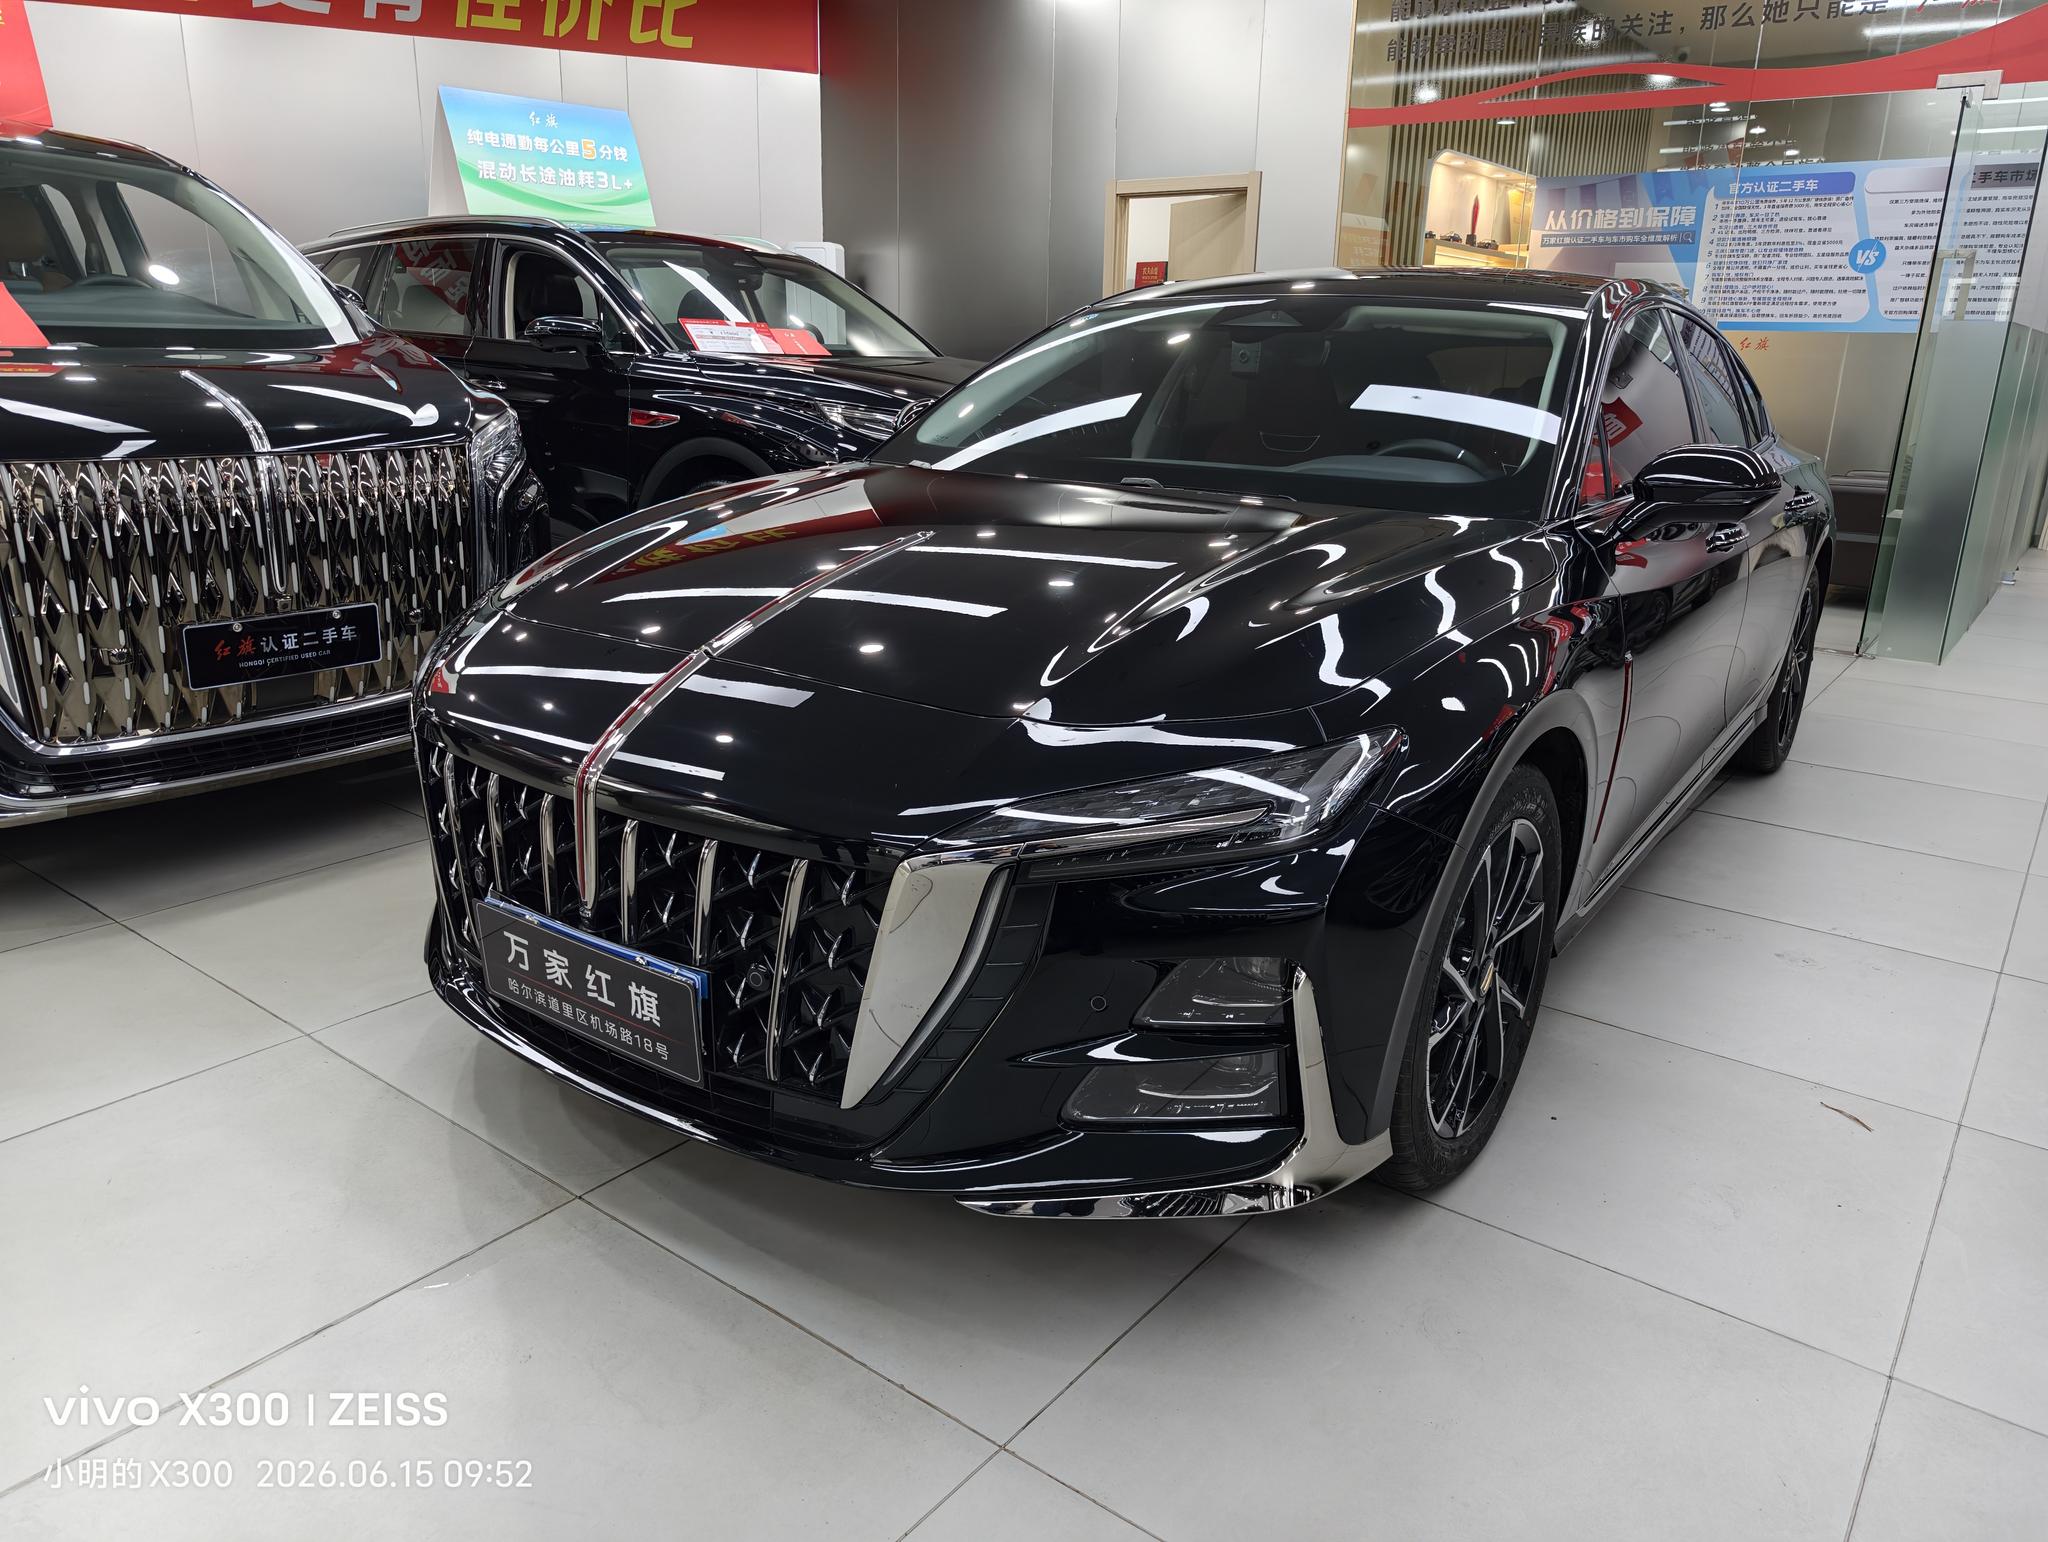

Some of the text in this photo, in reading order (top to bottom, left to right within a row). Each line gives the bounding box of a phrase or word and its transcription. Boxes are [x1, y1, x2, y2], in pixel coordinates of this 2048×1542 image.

[529, 111, 559, 129] 红旗
[467, 128, 629, 162] 纯电通勤每公里5分钱
[477, 160, 633, 191] 混动长途油耗3L+
[1972, 168, 2038, 184] 手车市场
[1729, 180, 1819, 195] 官方认证二手车
[1544, 206, 1697, 231] 从价格到保障
[1856, 246, 1880, 268] VS
[1739, 336, 1770, 351] 红旗
[239, 649, 331, 668] HONGQI CERTIFIED USED CAR
[503, 930, 661, 1027] 万家红旗
[507, 977, 670, 1060] 哈尔滨道里区机场路18号
